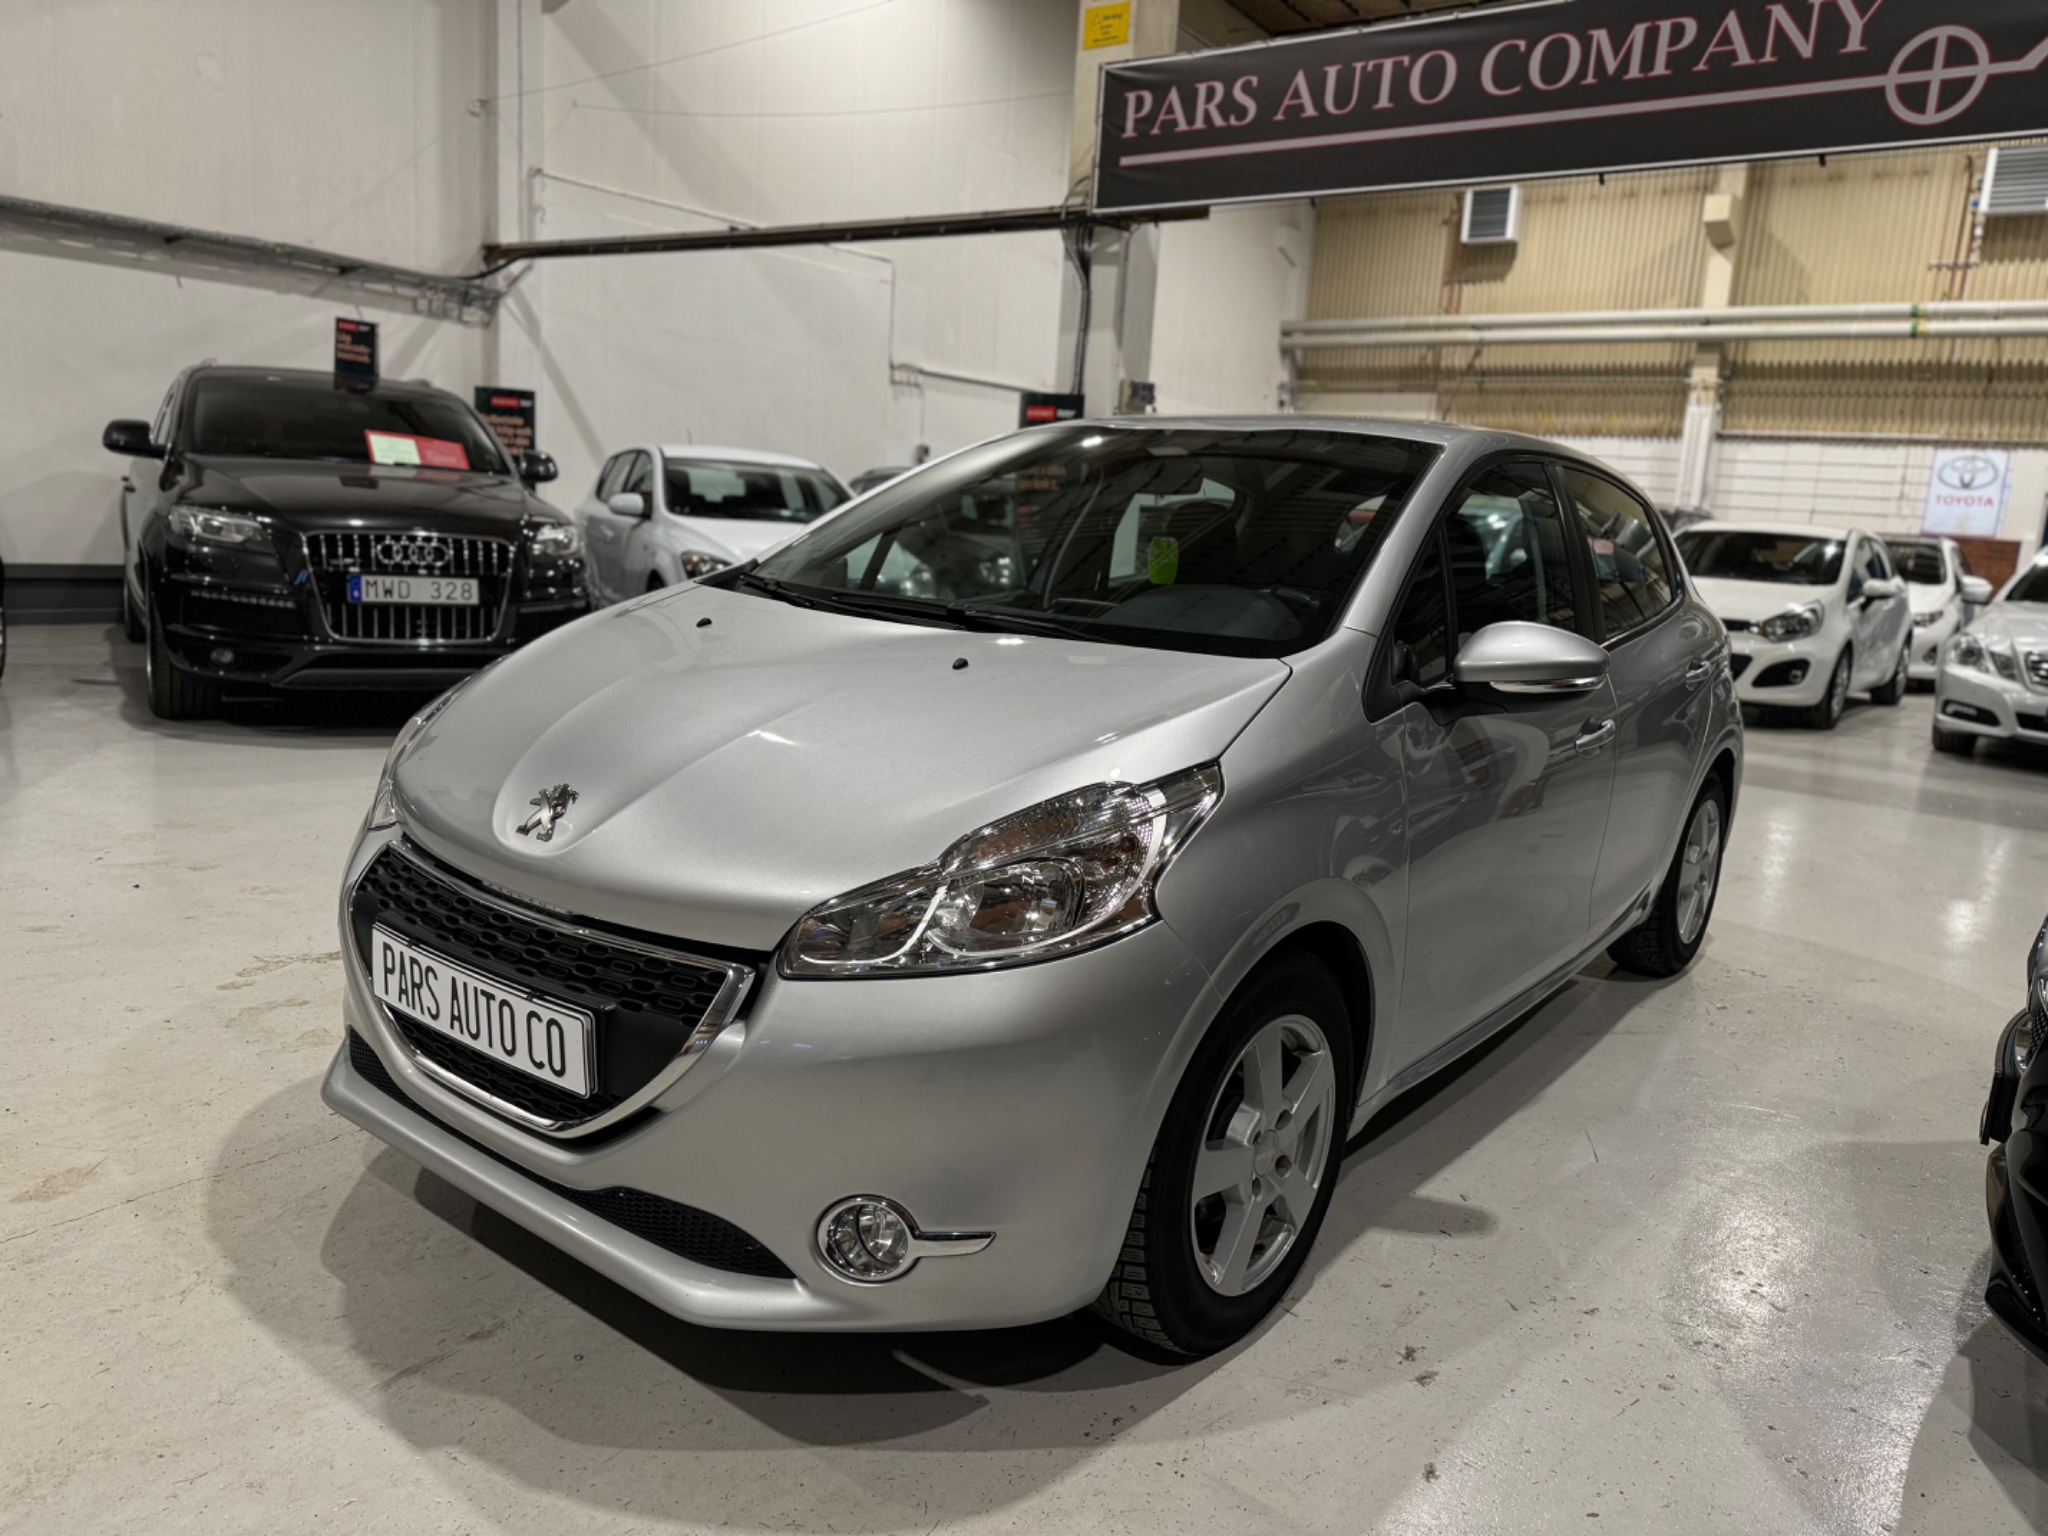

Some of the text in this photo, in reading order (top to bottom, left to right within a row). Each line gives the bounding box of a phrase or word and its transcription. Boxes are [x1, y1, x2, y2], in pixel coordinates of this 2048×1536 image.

[1121, 0, 1883, 138] PARS AUTO COMPANY
[1936, 494, 1994, 507] TOYOTA
[365, 579, 473, 600] MWD 328
[382, 941, 567, 1078] PARS AUTO CO
